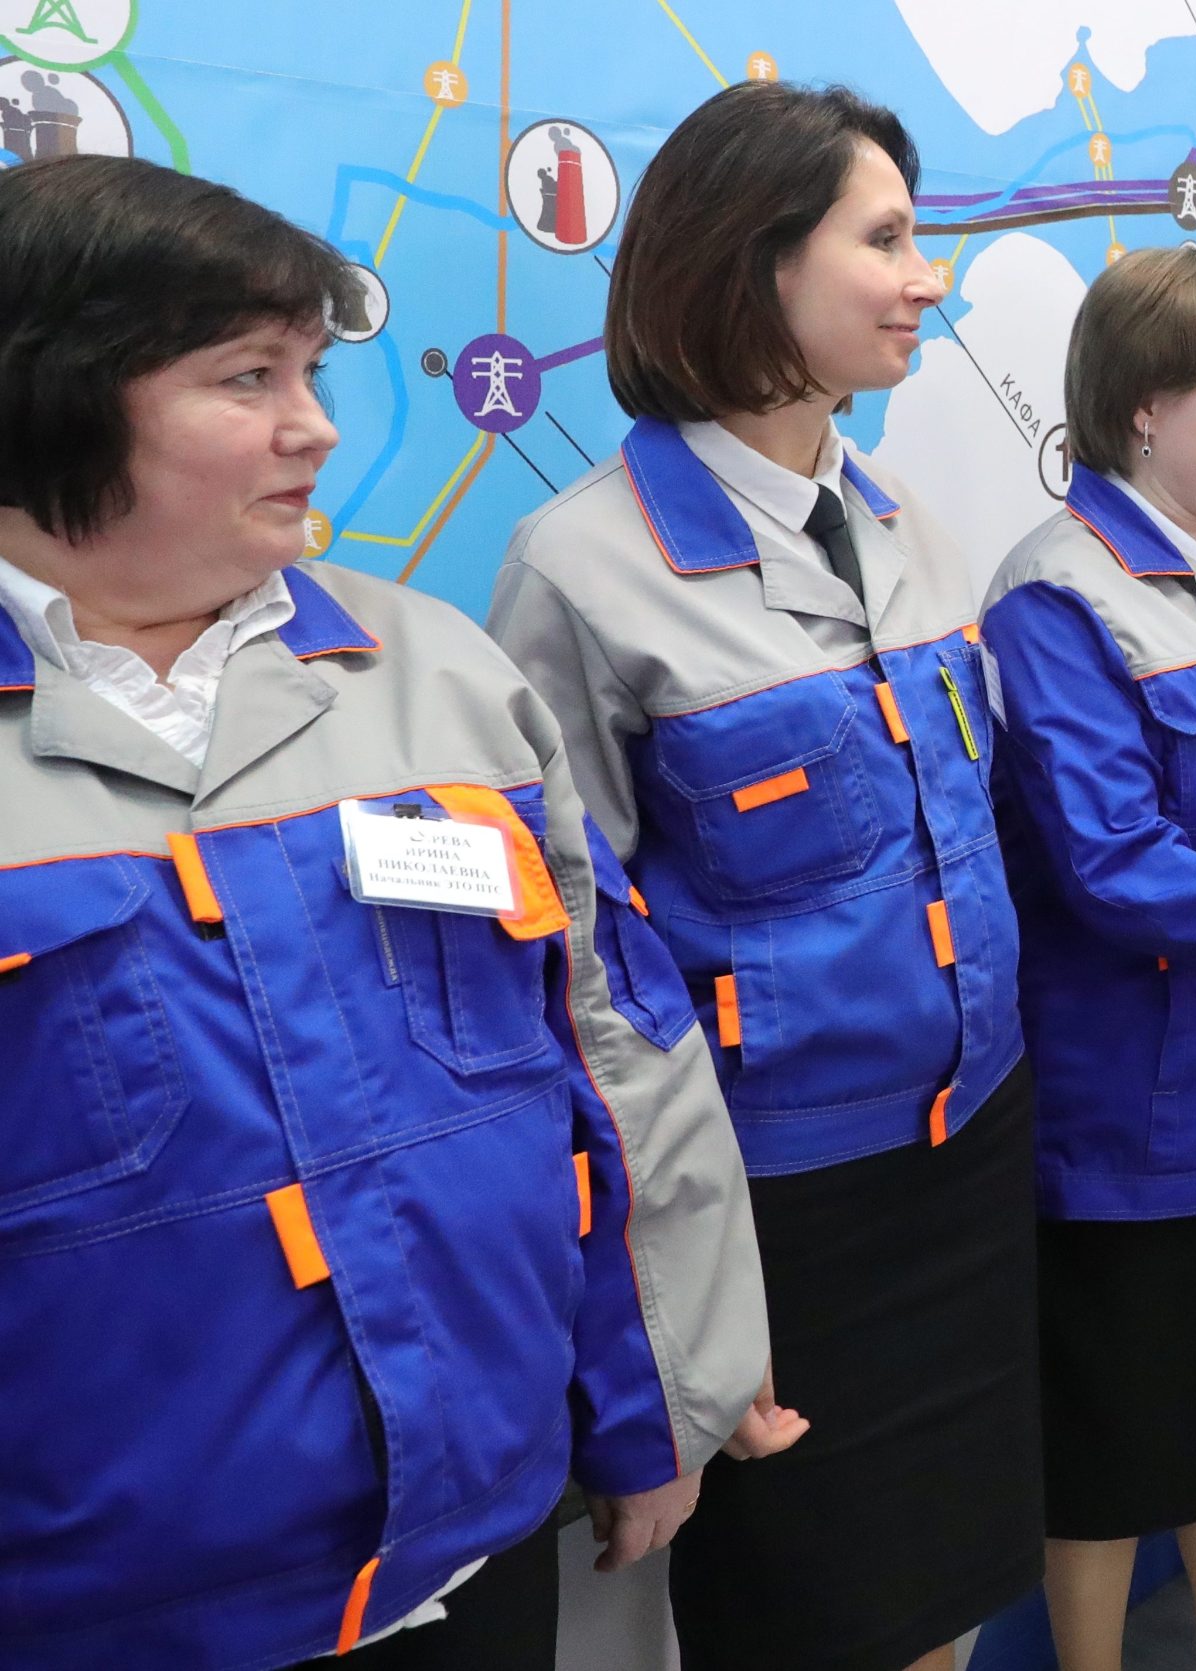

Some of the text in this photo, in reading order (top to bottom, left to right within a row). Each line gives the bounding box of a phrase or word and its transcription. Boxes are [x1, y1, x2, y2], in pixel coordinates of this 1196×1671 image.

[1000, 373, 1041, 438] КАФА
[405, 847, 462, 862] ИРИНА
[378, 858, 491, 880] НИКОЛАЕВНА
[369, 872, 441, 888] Начальник
